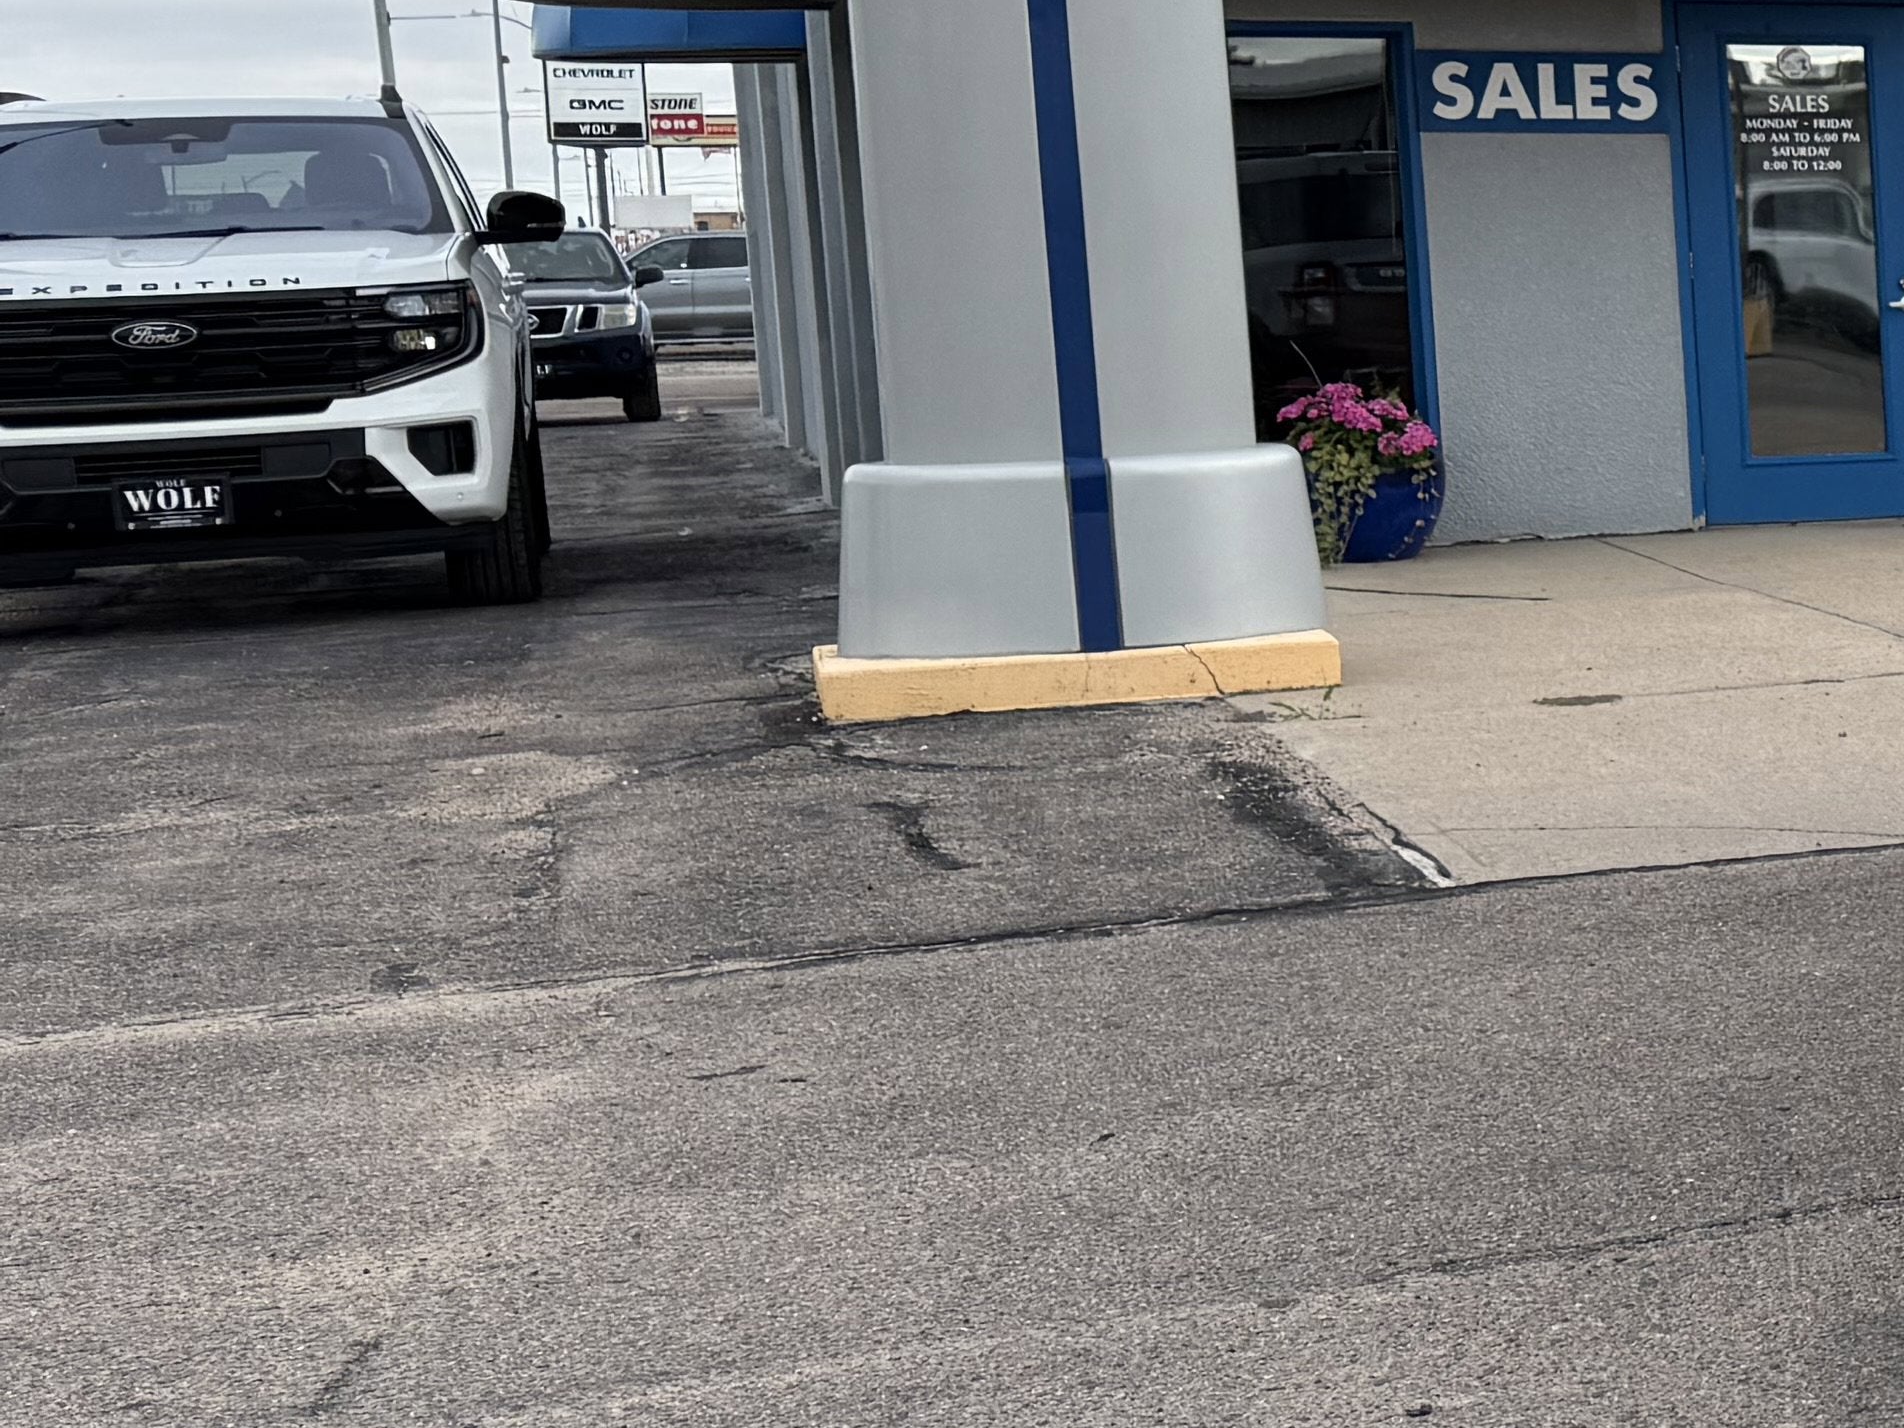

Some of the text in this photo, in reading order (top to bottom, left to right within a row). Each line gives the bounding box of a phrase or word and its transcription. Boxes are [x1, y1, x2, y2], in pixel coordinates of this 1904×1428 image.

[553, 67, 635, 78] CHEVROLET
[1432, 61, 1658, 121] SALES
[569, 99, 624, 110] GMC
[1768, 95, 1830, 113] SALES
[1745, 118, 1799, 129] MONDAY
[1813, 118, 1853, 129] FRIDAY
[579, 124, 617, 135] WOLF
[1740, 132, 1860, 143] 8:00 AM TO 6:00 PM
[1771, 146, 1831, 157] SATURDAY
[1762, 160, 1842, 170] 8:00 TO 12:00
[0, 277, 300, 296] EXPEDITION
[128, 325, 181, 345] Ford
[123, 485, 221, 512] WOLF
